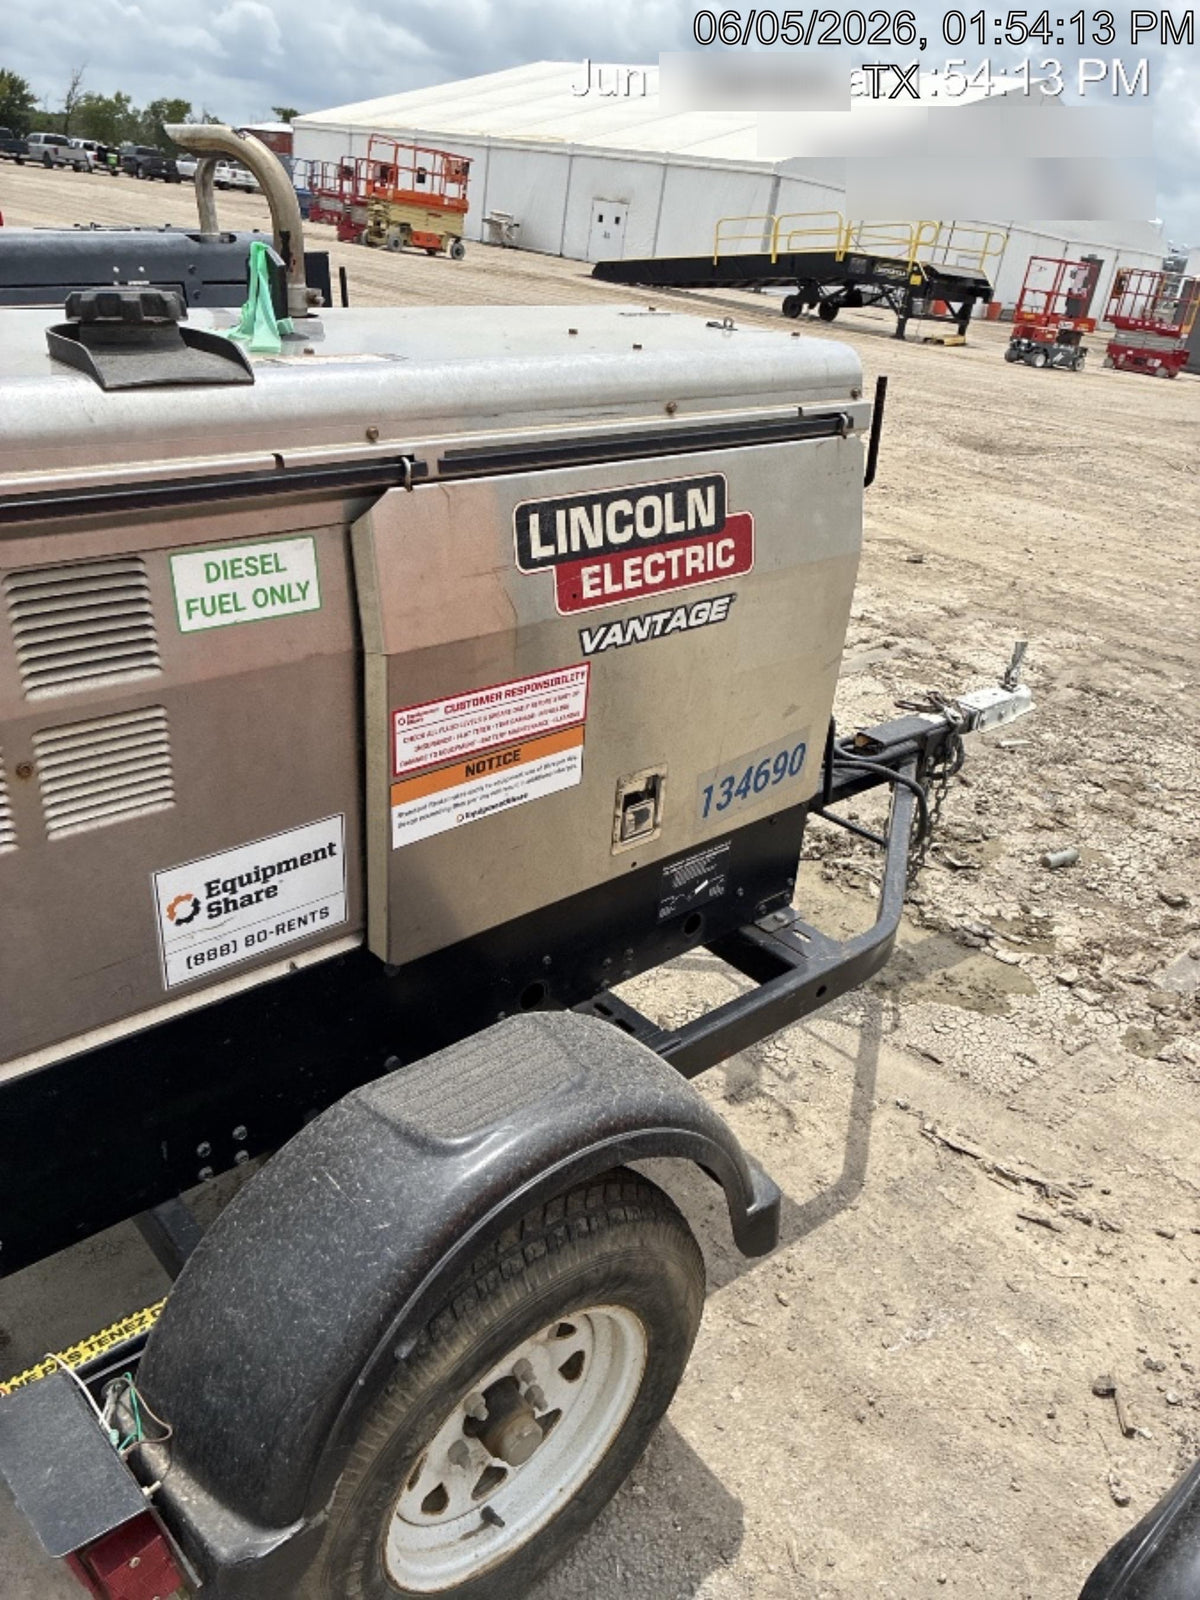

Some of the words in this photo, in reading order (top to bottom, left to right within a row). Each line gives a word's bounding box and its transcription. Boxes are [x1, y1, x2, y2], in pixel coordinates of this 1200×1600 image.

[529, 485, 717, 559] LINCOLN
[204, 552, 288, 583] DIESEL
[581, 538, 736, 600] ELECTRIC
[185, 591, 247, 620] FUEL
[252, 580, 310, 608] ONLY
[579, 595, 735, 655] VANTAGE
[444, 692, 503, 715] CUSTOMER
[504, 671, 586, 698] RESPONSIBILITY
[464, 748, 522, 777] NOTICE
[702, 742, 807, 819] 134690
[205, 842, 338, 899] Equipment
[207, 884, 279, 920] Share
[186, 940, 238, 970] (888)
[244, 906, 331, 947] 80-RENTS
